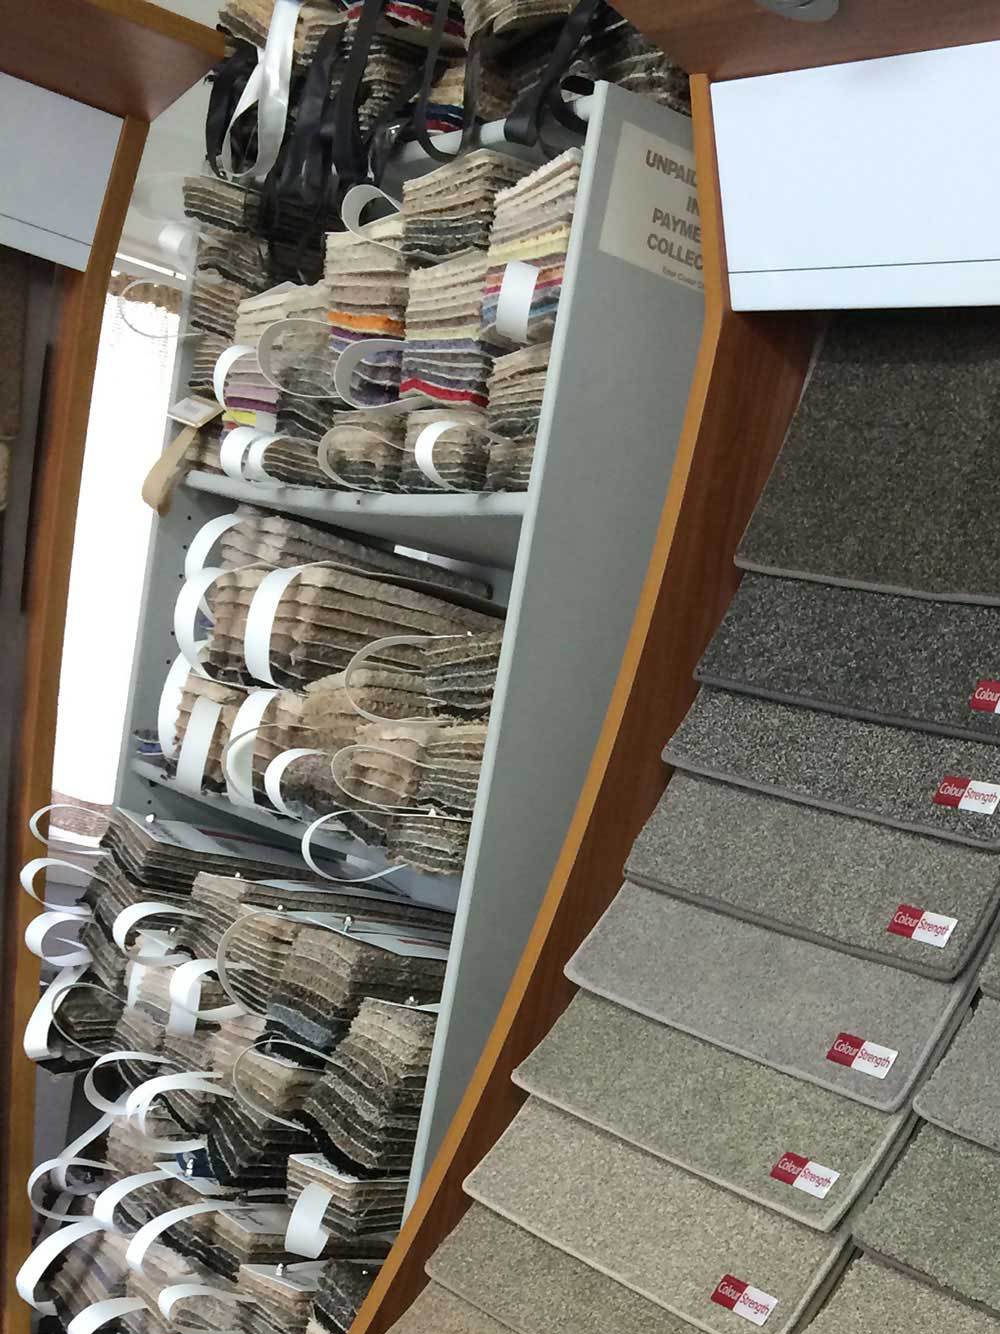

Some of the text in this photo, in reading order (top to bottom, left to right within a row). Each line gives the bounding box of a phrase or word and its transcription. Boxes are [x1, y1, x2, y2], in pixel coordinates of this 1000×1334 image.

[975, 687, 1000, 701] Colour
[939, 782, 998, 805] Colour Strength
[893, 911, 950, 937] Colour Strength
[833, 1039, 891, 1069] Colour Strength
[778, 1158, 831, 1188] Colour Strength
[718, 1281, 770, 1315] Colour Strength
